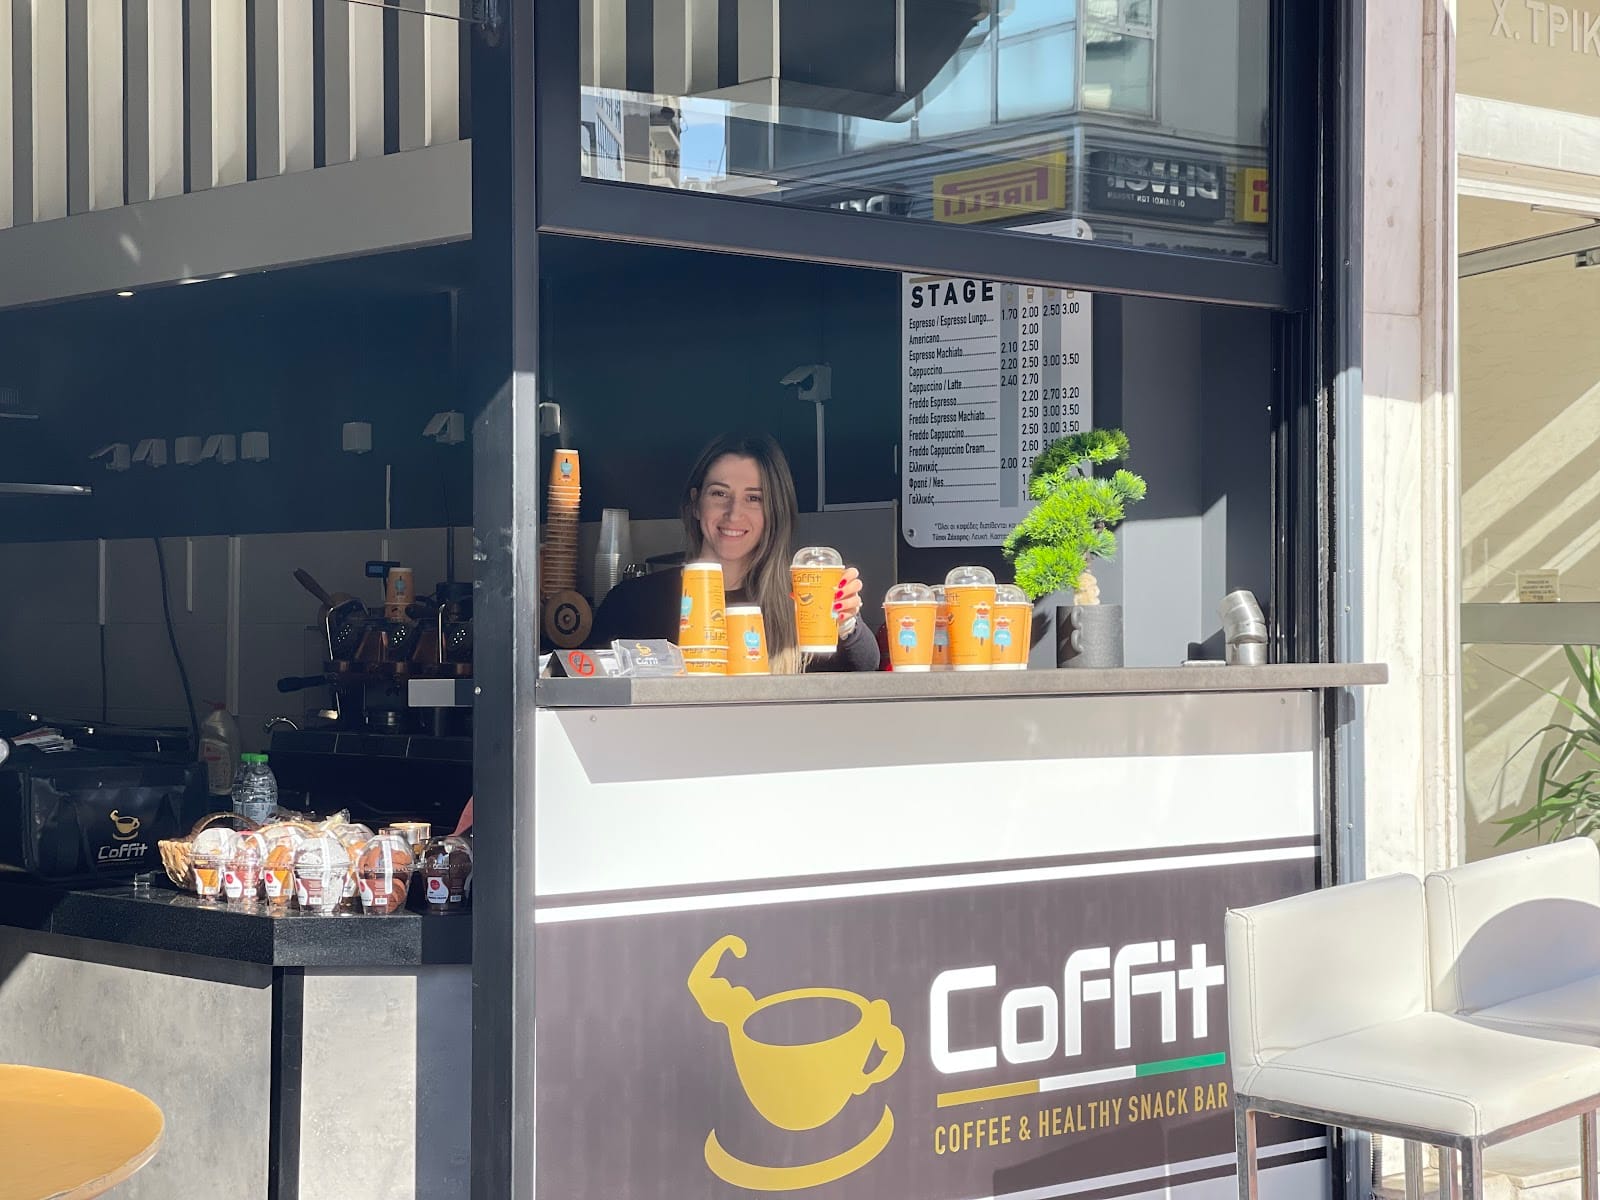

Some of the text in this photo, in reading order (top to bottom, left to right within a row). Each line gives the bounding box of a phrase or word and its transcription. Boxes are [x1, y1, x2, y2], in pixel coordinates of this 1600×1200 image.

[911, 280, 994, 308] STAGE
[909, 318, 935, 331] Espresso
[941, 315, 967, 328] Espresso
[969, 312, 987, 325] Lungo
[1001, 308, 1017, 320] 1.70
[1022, 306, 1038, 318] 2.00
[1043, 304, 1060, 316] 2.50
[1062, 302, 1079, 314] 3.00
[909, 323, 1038, 345] Americano 2.00
[909, 350, 935, 363] Espresso
[1001, 342, 1017, 354] 2.10
[1022, 340, 1038, 352] 2.50
[909, 353, 1079, 378] Cappuccino 2.20 2.50 3.00 3.50
[909, 380, 942, 394] Cappuccino
[948, 379, 962, 390] Latte
[1001, 375, 1017, 387] 2.40
[1022, 373, 1038, 385] 2.70
[931, 396, 956, 409] Espresso
[1022, 390, 1038, 402] 2.20
[1043, 388, 1060, 400] 2.70
[1062, 387, 1079, 399] 3.20
[931, 412, 956, 425] Espresso
[1022, 406, 1038, 418] 2.50
[1043, 405, 1060, 417] 3.00
[1062, 403, 1079, 415] 3.50
[931, 427, 964, 441] Cappuccino
[1022, 423, 1038, 435] 2.50
[1043, 422, 1060, 434] 3.00
[1062, 421, 1079, 433] 3.50
[931, 443, 964, 457] Cappuccino
[1022, 440, 1038, 452] 2.60
[1001, 457, 1017, 469] 2.00
[1022, 456, 1036, 468] 2.5
[98, 843, 148, 860] Coffit
[930, 939, 1225, 1074] Coffit
[934, 1081, 1228, 1155] COFFEE & HEALTHY SNACK BAR
